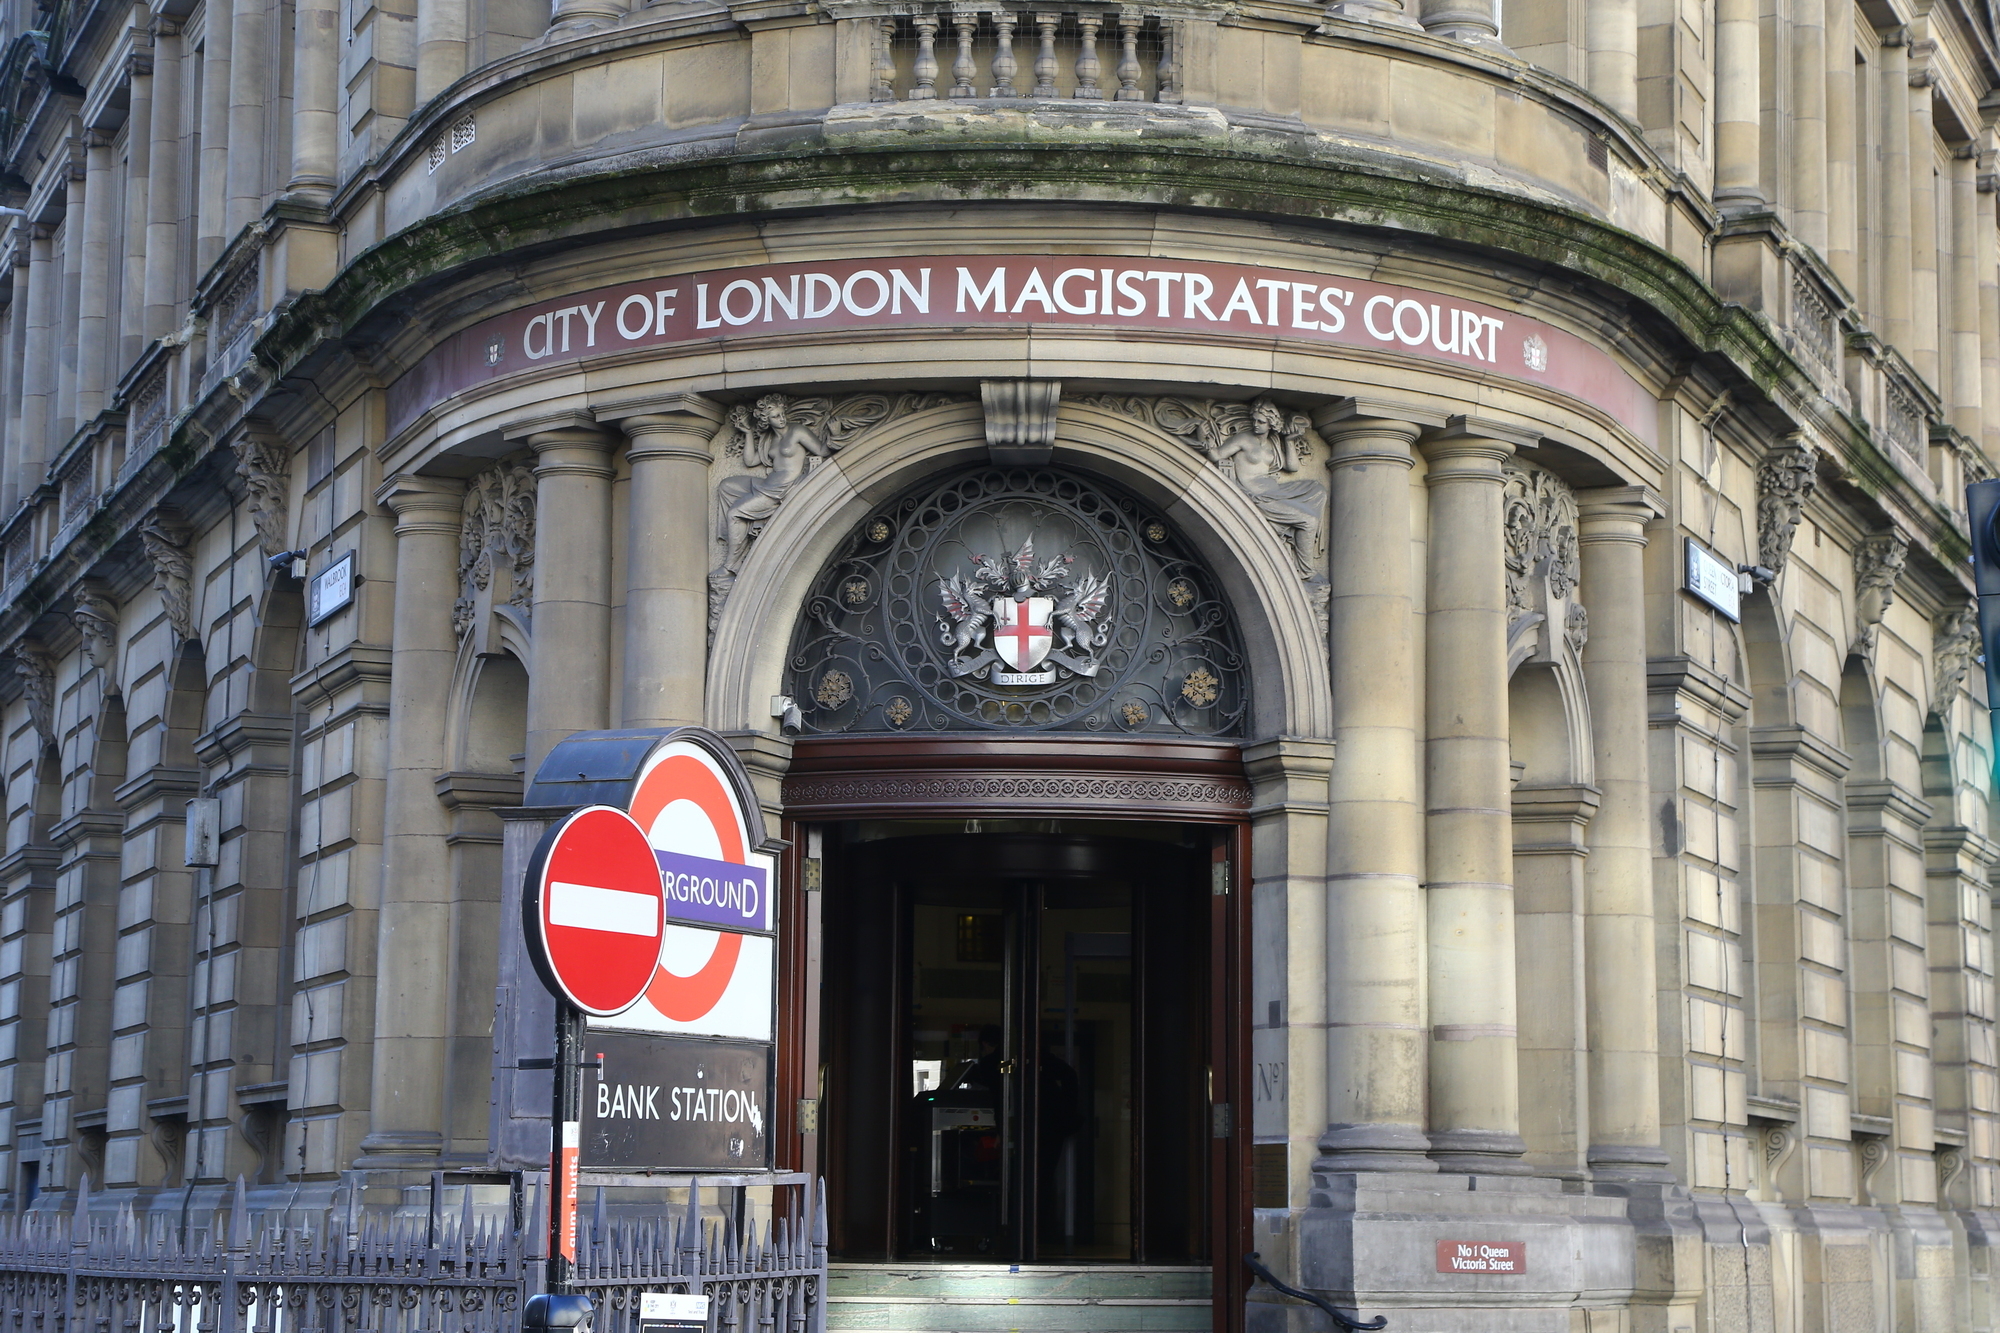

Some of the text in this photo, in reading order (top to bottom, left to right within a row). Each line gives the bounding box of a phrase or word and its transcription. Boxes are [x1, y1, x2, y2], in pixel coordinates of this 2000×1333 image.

[523, 301, 606, 360] CITY
[616, 288, 679, 340] OF
[696, 267, 932, 330] LONDON
[1363, 295, 1504, 363] COURT
[324, 564, 348, 590] WALBROOK
[1000, 674, 1045, 683] DIRIGE
[661, 869, 759, 918] RGROUND
[596, 1082, 756, 1123] BANK STATION
[567, 1155, 579, 1199] butts
[1451, 1256, 1514, 1270] Victoria Street
[1457, 1244, 1473, 1257] No
[1480, 1244, 1509, 1259] Queen
